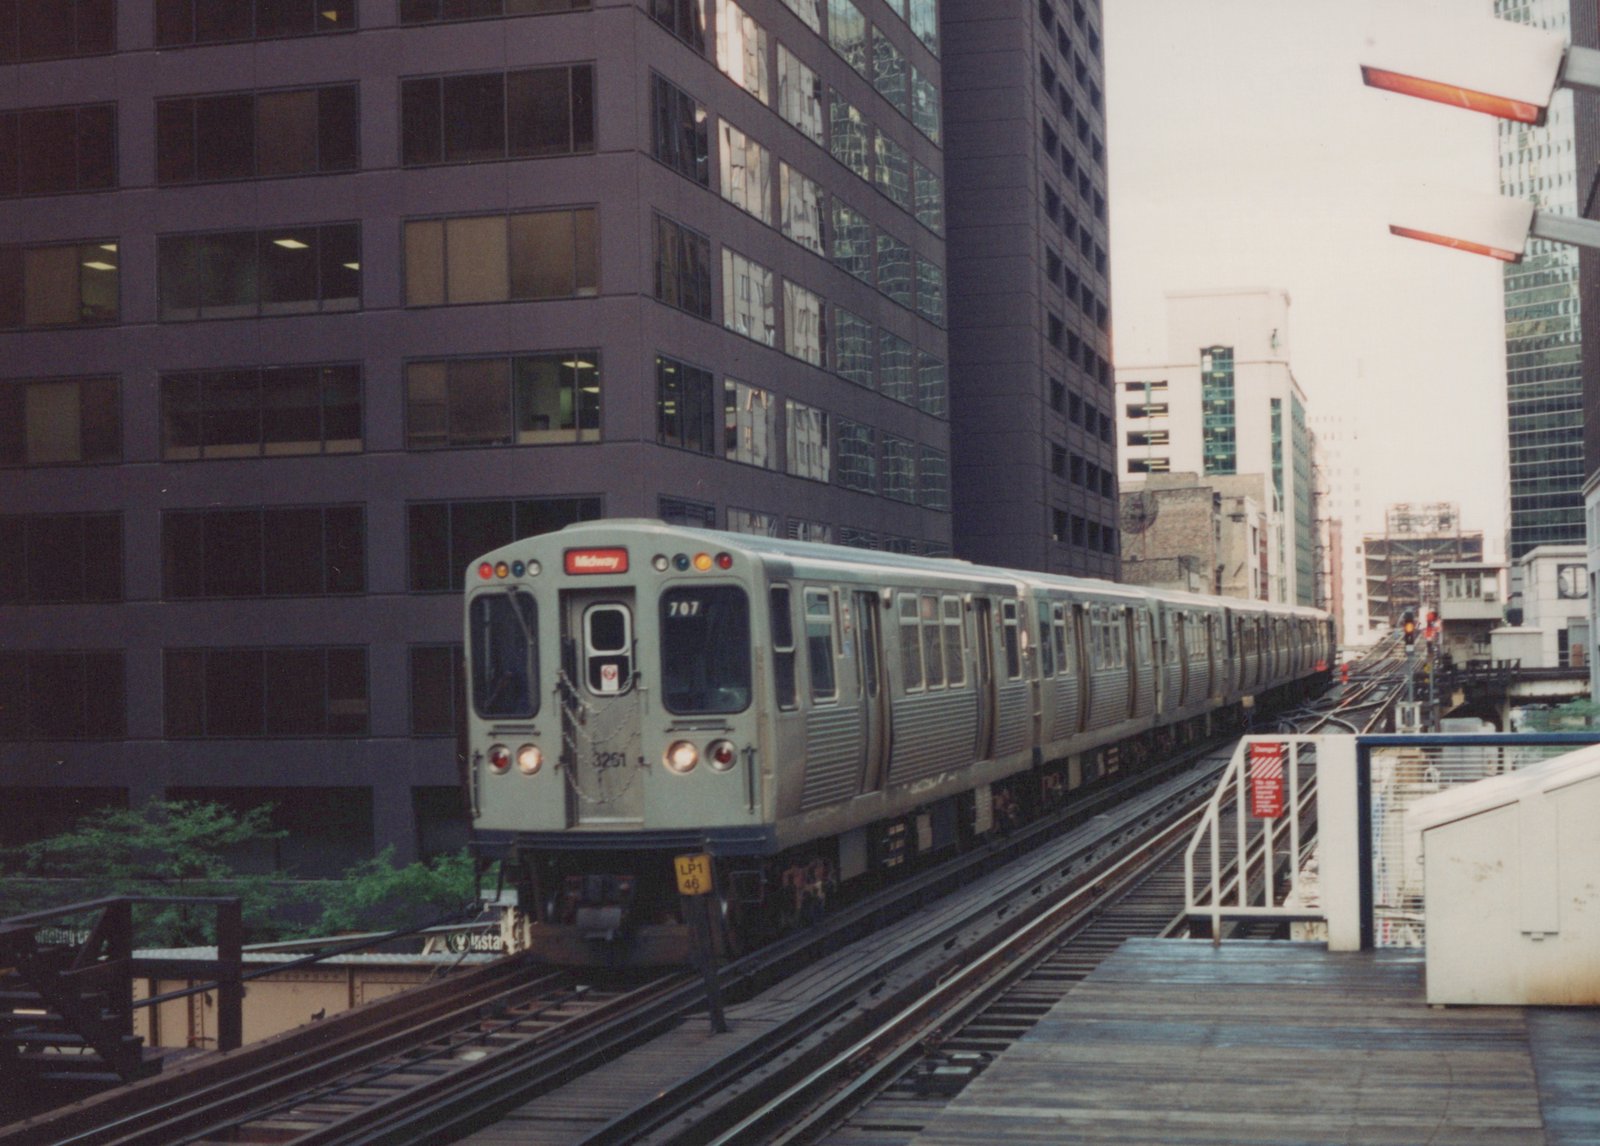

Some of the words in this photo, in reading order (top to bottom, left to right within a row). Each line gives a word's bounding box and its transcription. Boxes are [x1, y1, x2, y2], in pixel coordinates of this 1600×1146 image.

[574, 554, 619, 569] Midway
[670, 601, 699, 616] 707
[680, 863, 703, 875] LP1
[684, 878, 700, 890] 46
